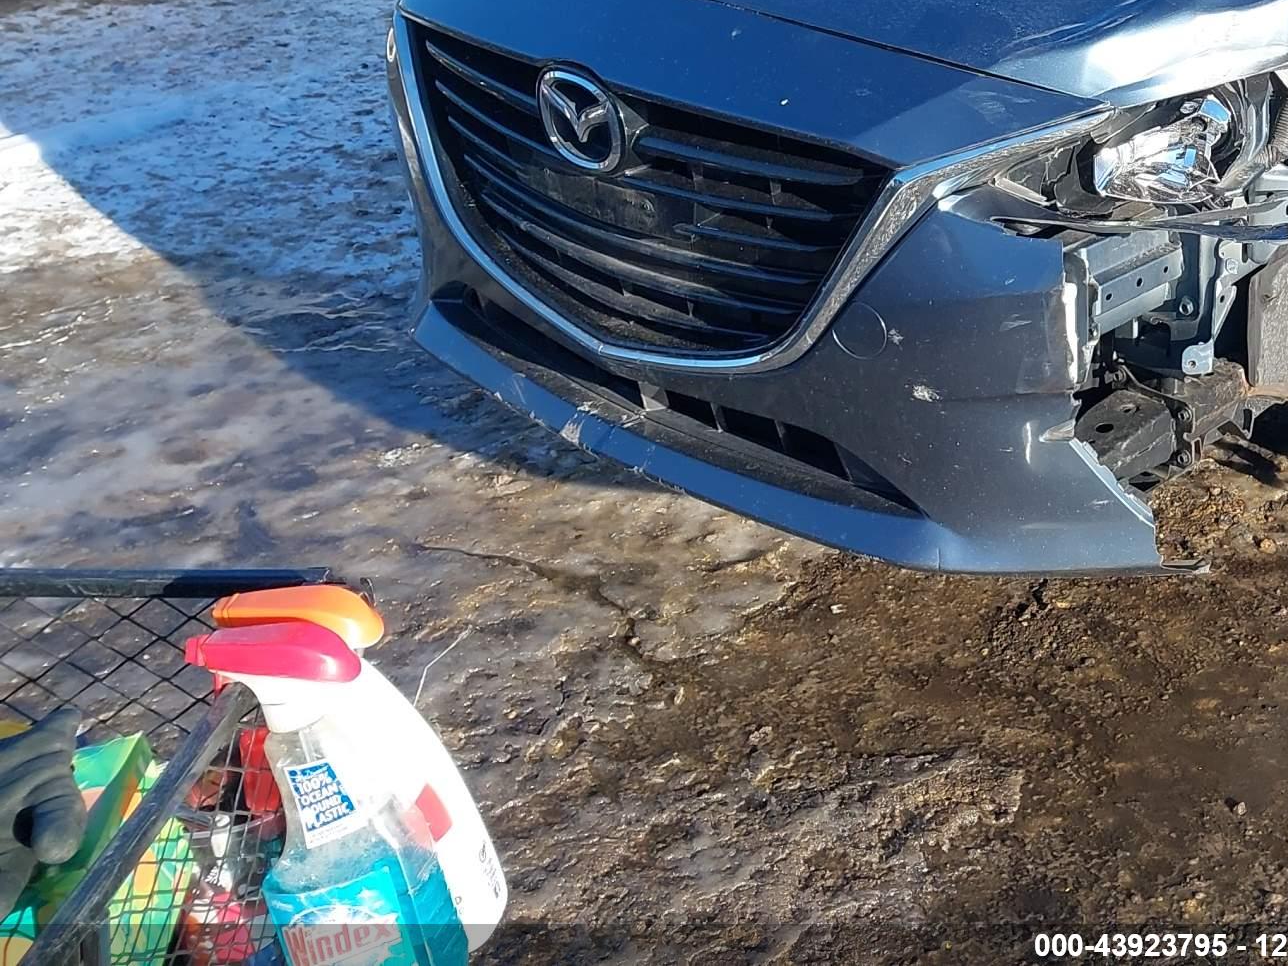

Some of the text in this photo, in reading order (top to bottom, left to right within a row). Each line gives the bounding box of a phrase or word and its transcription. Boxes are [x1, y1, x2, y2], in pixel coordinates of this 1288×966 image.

[297, 772, 333, 795] 100%
[300, 783, 339, 805] OCEAN
[284, 919, 392, 966] Windex
